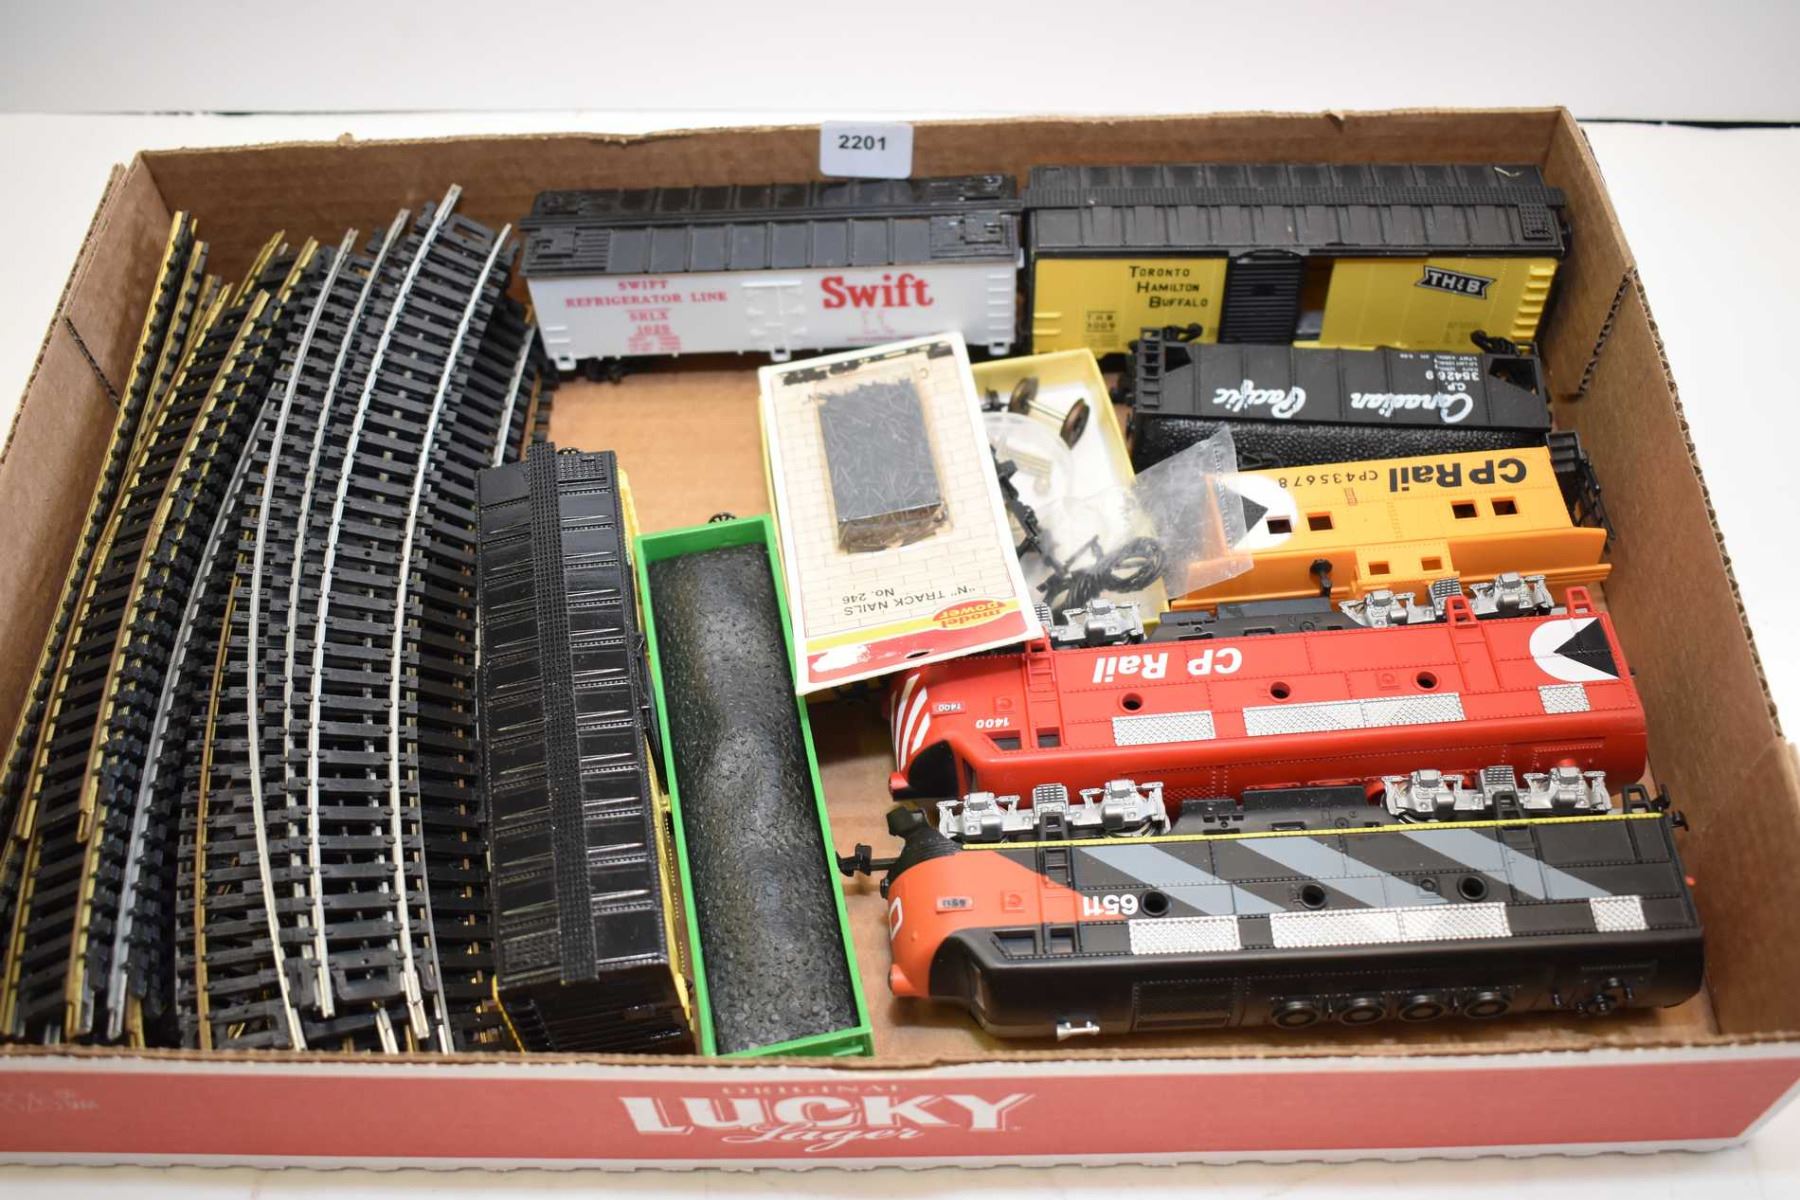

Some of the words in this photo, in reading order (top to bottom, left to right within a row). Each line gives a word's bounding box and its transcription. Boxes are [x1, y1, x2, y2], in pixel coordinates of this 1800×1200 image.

[838, 134, 886, 151] 2201
[1129, 265, 1190, 278] TORONTO
[618, 279, 668, 290] SWIFT
[820, 273, 934, 309] Swift
[1137, 281, 1199, 293] HAMILTON
[565, 293, 683, 308] REFRIGERATOR
[690, 291, 728, 303] LINE
[1148, 296, 1208, 308] BUFFALO
[1213, 379, 1306, 419] Pacific
[1351, 391, 1473, 423] Canadian
[1389, 462, 1463, 492] Rail
[1469, 457, 1527, 485] CP
[842, 592, 866, 604] 246
[871, 587, 895, 597] No.
[895, 590, 945, 607] TRACK
[844, 601, 889, 616] NAILS
[940, 601, 1001, 619] power
[941, 608, 1002, 629] model
[1092, 653, 1168, 684] Rail
[1187, 647, 1243, 676] CP
[975, 717, 1010, 729] 1400
[1083, 893, 1139, 916] 6511
[619, 1093, 1036, 1135] LUCKY
[720, 1121, 925, 1153] Lager
